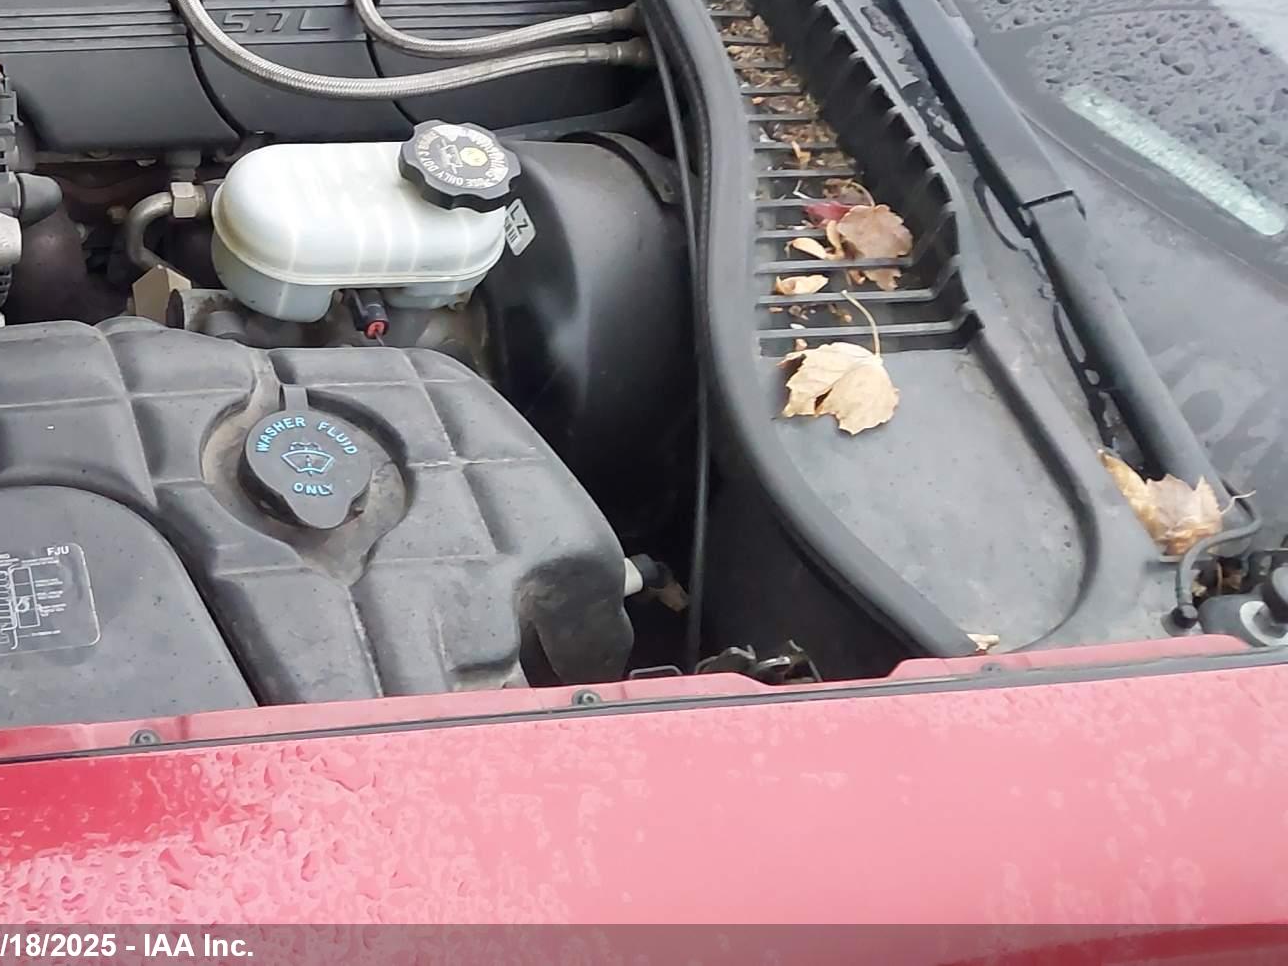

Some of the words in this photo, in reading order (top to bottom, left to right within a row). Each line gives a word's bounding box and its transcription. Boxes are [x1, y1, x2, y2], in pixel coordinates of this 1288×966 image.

[222, 10, 331, 33] 5.7L
[256, 417, 306, 452] WASHER
[317, 421, 359, 454] FLUID
[293, 482, 333, 495] ONLY
[47, 546, 69, 556] FJU
